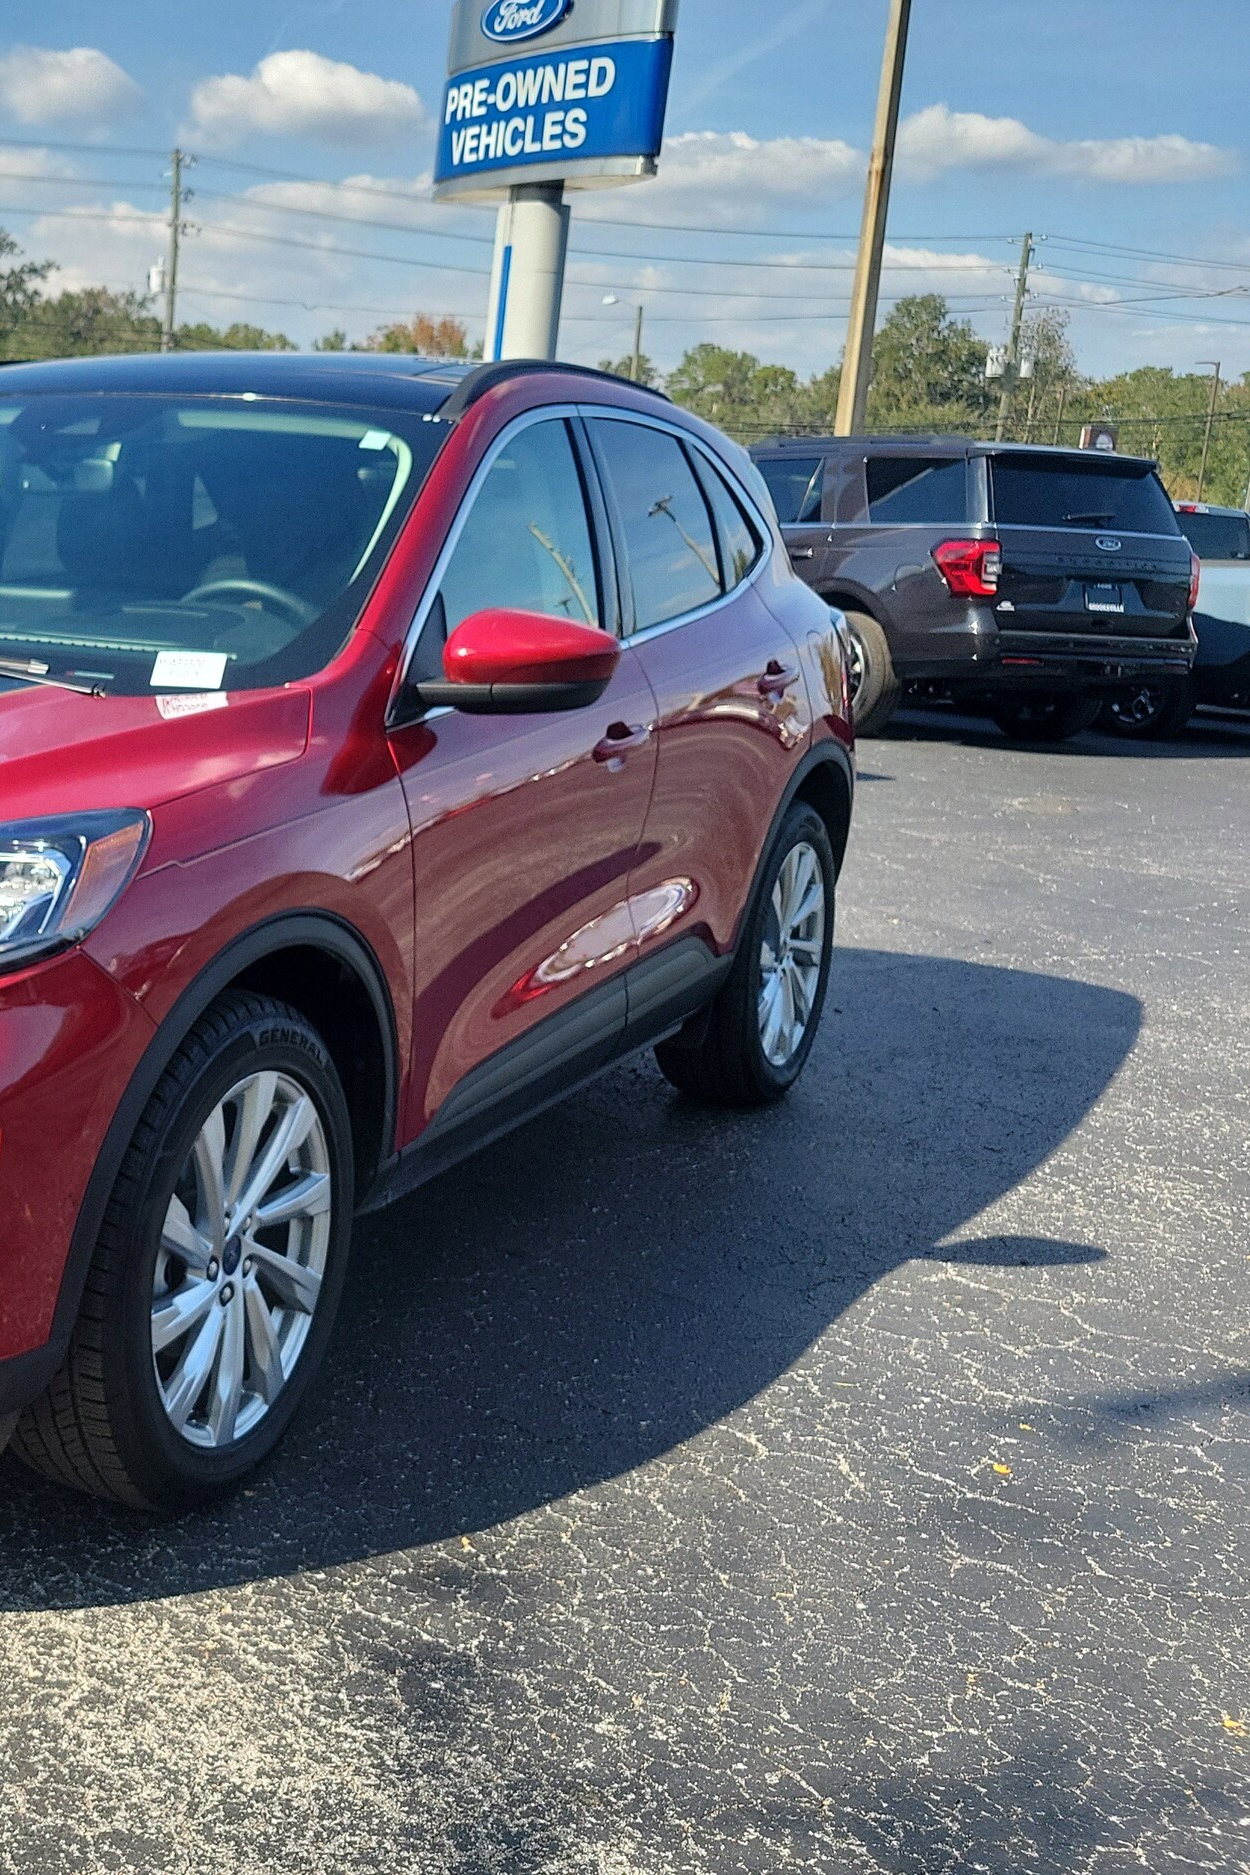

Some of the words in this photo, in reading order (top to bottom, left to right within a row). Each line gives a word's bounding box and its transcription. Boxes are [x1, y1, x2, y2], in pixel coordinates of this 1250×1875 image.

[494, 0, 546, 33] Ford
[445, 57, 616, 125] PRE-OWNED
[452, 108, 588, 166] VEHICLES
[259, 1026, 325, 1064] GENERAL
